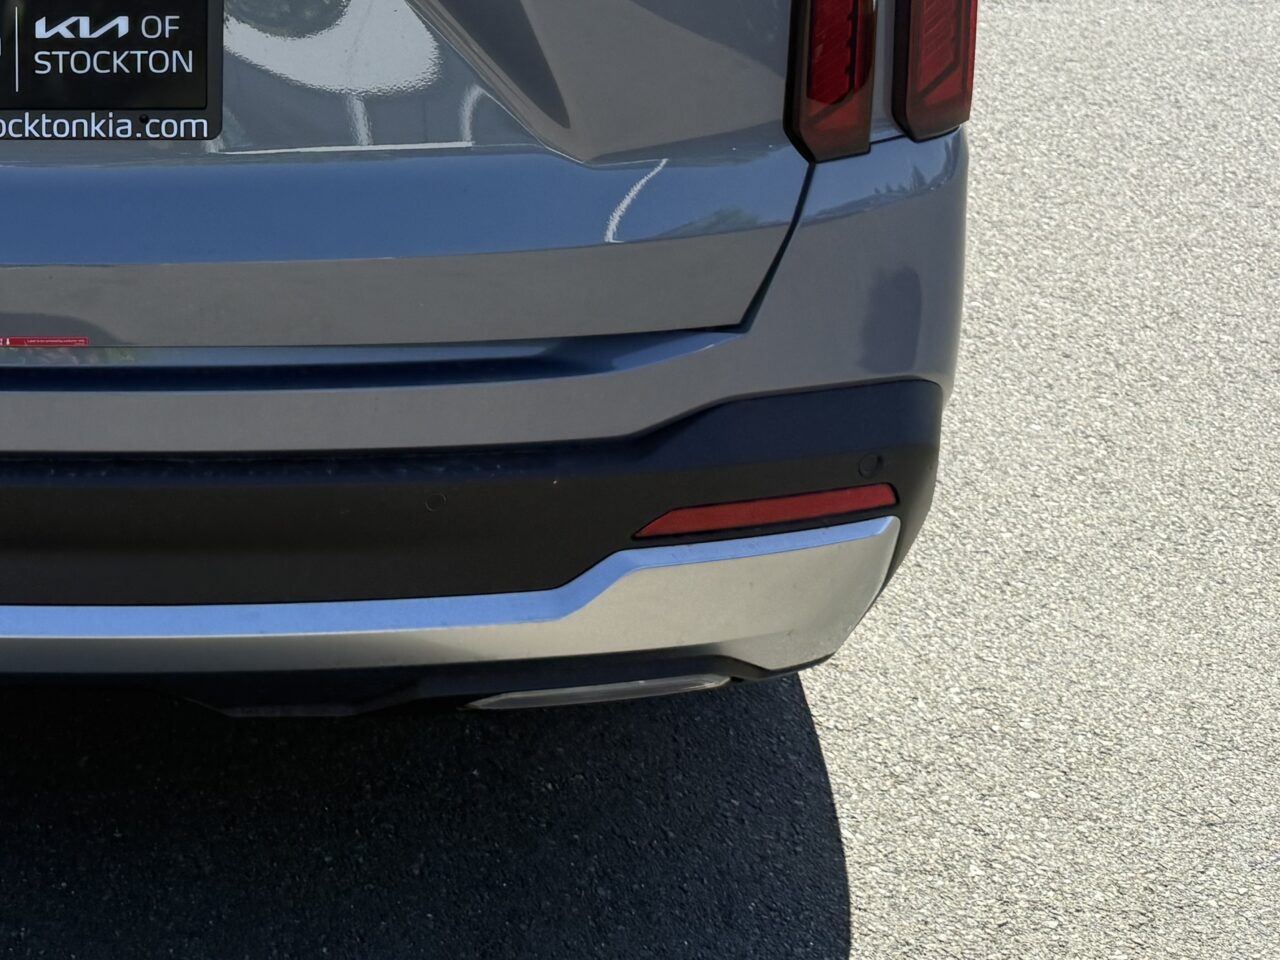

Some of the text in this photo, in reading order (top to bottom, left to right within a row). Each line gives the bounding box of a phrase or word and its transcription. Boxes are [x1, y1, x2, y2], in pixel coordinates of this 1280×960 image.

[34, 15, 180, 39] KIA OF
[33, 50, 193, 75] STOCKTON
